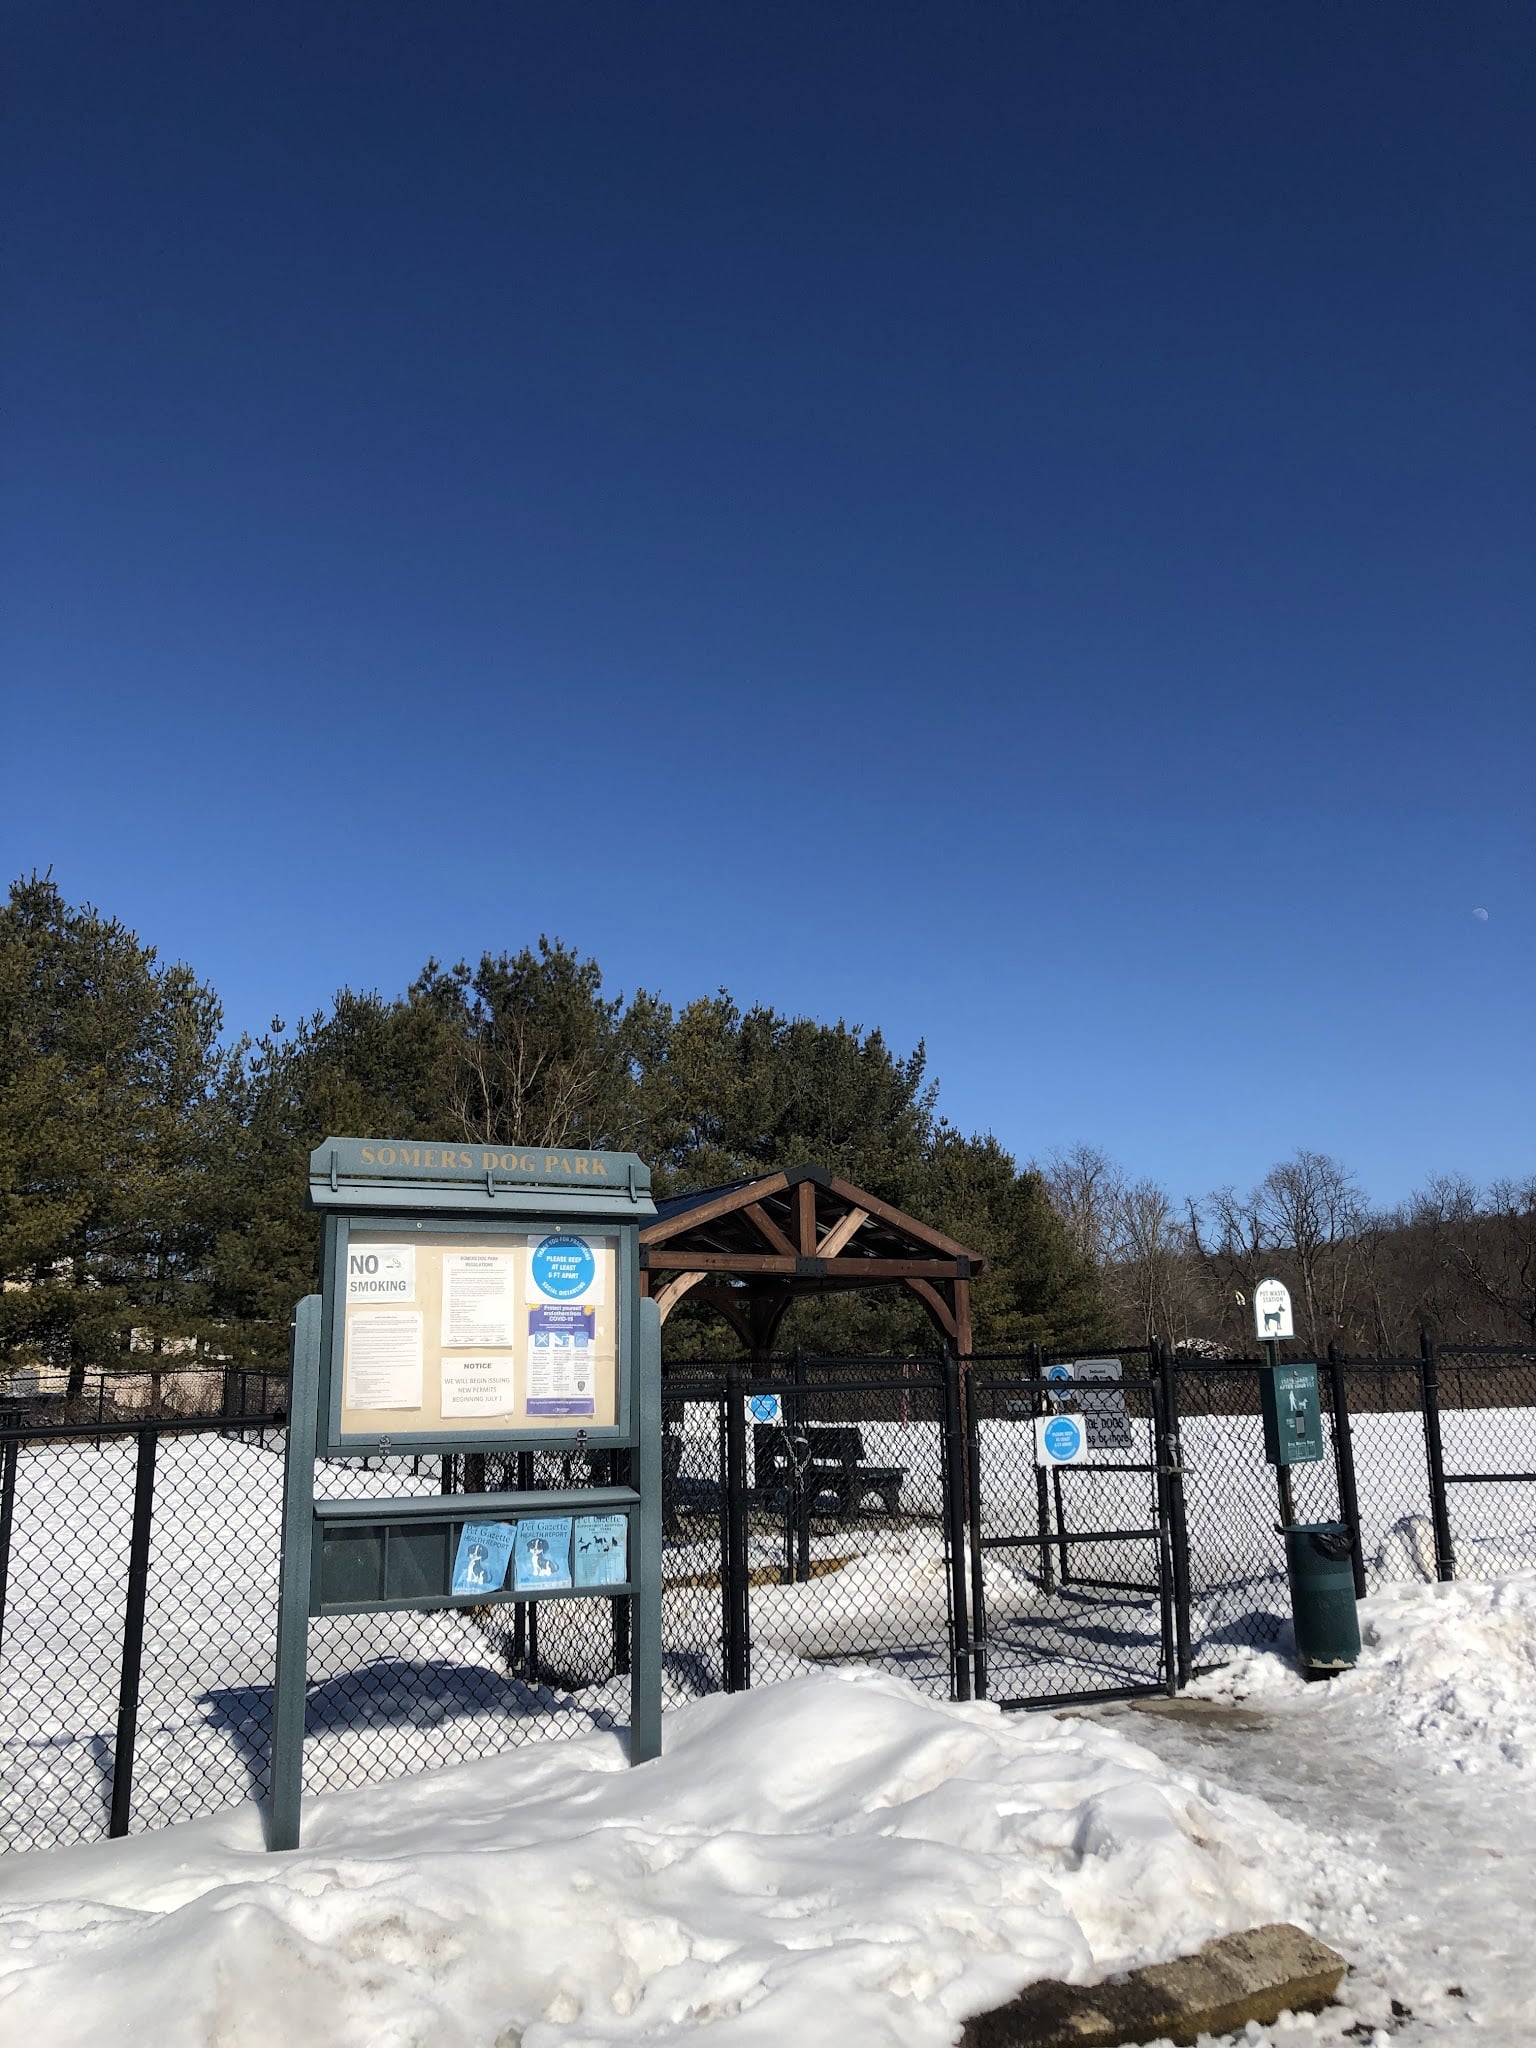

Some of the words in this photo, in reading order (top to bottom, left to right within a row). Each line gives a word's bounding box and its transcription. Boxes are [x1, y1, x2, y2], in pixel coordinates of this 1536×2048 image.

[360, 1147, 473, 1169] SOMERS
[481, 1152, 536, 1172] DOG
[544, 1156, 608, 1176] PARK
[350, 1254, 380, 1275] NO
[546, 1255, 567, 1263] PLEASE
[350, 1280, 407, 1293] SMOKING
[463, 1362, 492, 1370] NOTICE
[521, 1522, 534, 1531] Pet
[537, 1521, 569, 1531] Gazette
[466, 1524, 479, 1535] Pet
[480, 1527, 511, 1543] Gazette
[463, 1535, 486, 1545] HEALTH
[486, 1539, 510, 1550] REPORT
